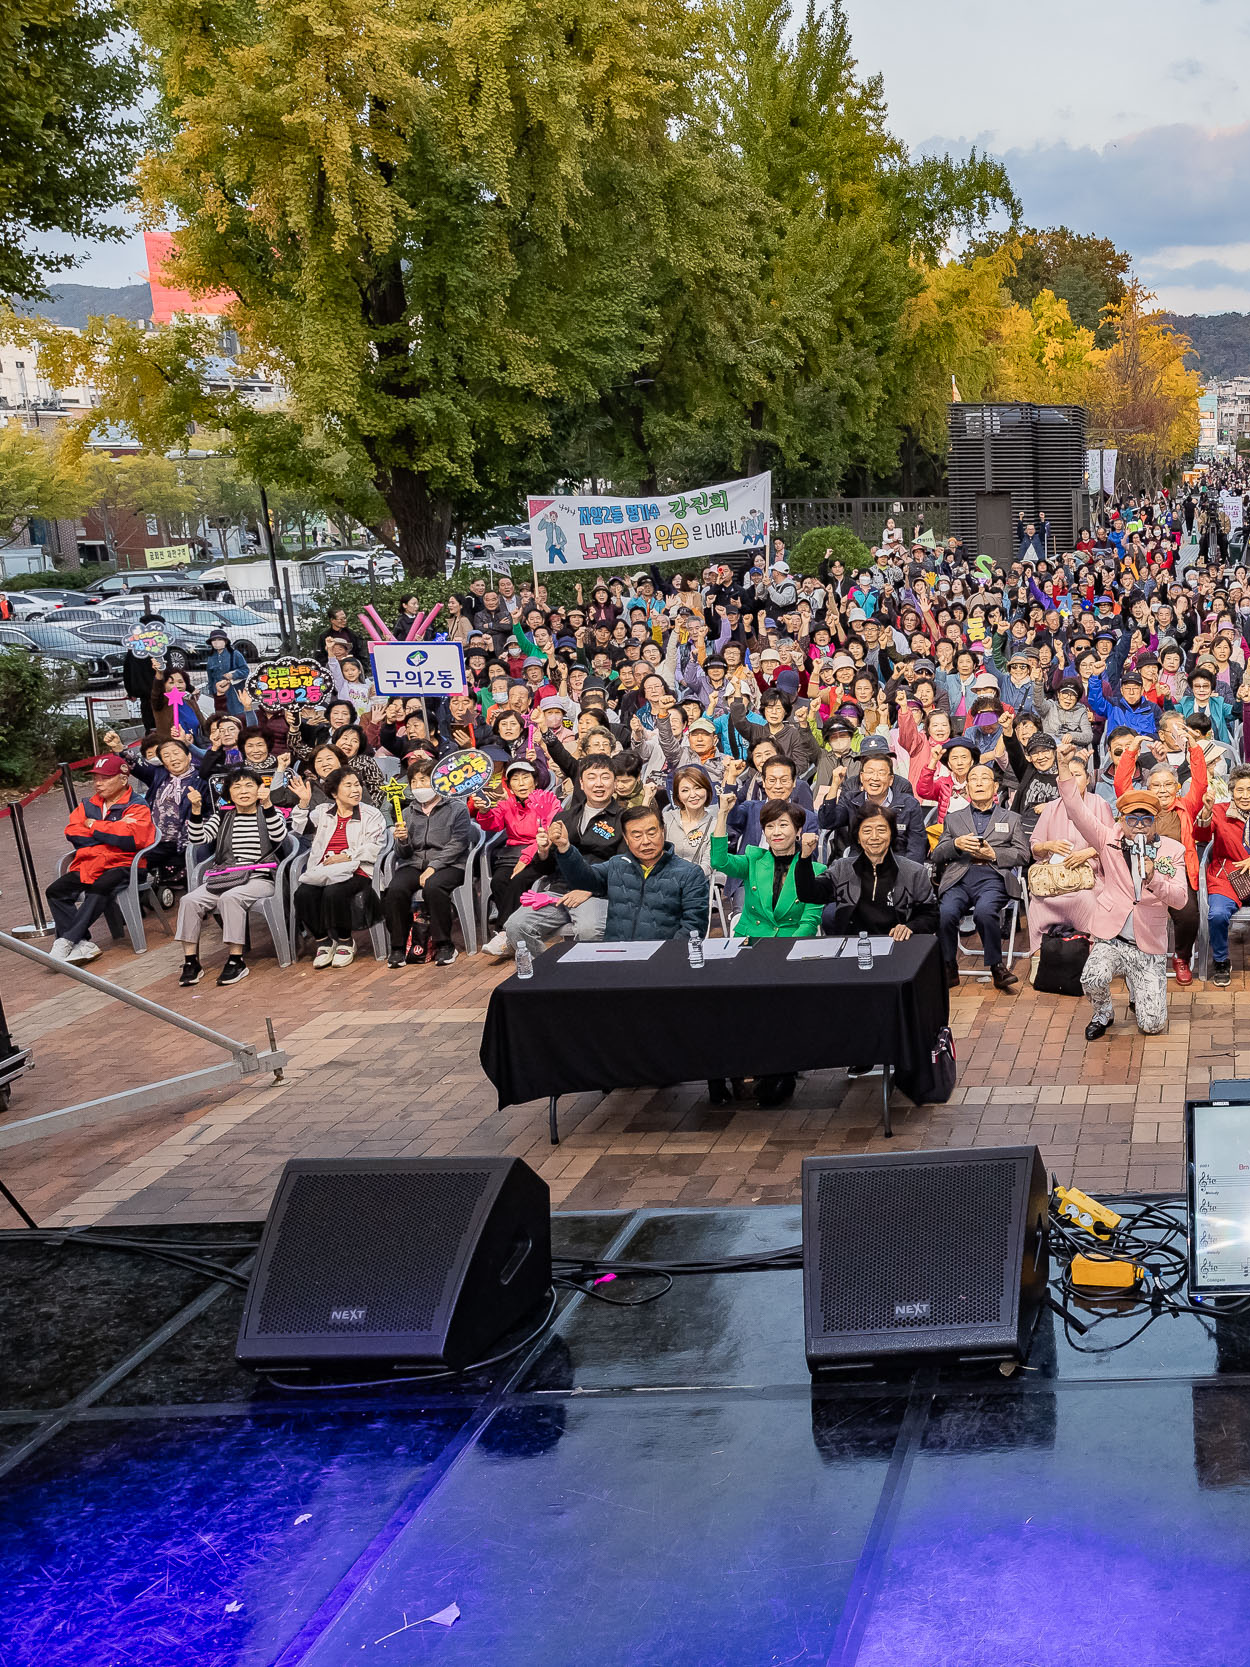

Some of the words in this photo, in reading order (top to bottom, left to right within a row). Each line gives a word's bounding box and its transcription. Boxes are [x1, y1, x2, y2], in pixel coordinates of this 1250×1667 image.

[578, 506, 624, 526] 자양2동
[626, 503, 661, 523] 명가수
[668, 490, 728, 519] 강진희
[579, 527, 651, 560] 노래자랑
[654, 522, 689, 552] 우승
[692, 526, 703, 541] 은
[705, 520, 738, 539] 나야나!
[967, 617, 986, 642] 동
[267, 665, 312, 678] 슈퍼스타
[385, 670, 455, 689] 구의2동
[262, 686, 323, 706] 구의2동
[434, 756, 488, 792] 구의2동
[331, 1309, 366, 1321] NEXT
[895, 1302, 929, 1316] NEXT
